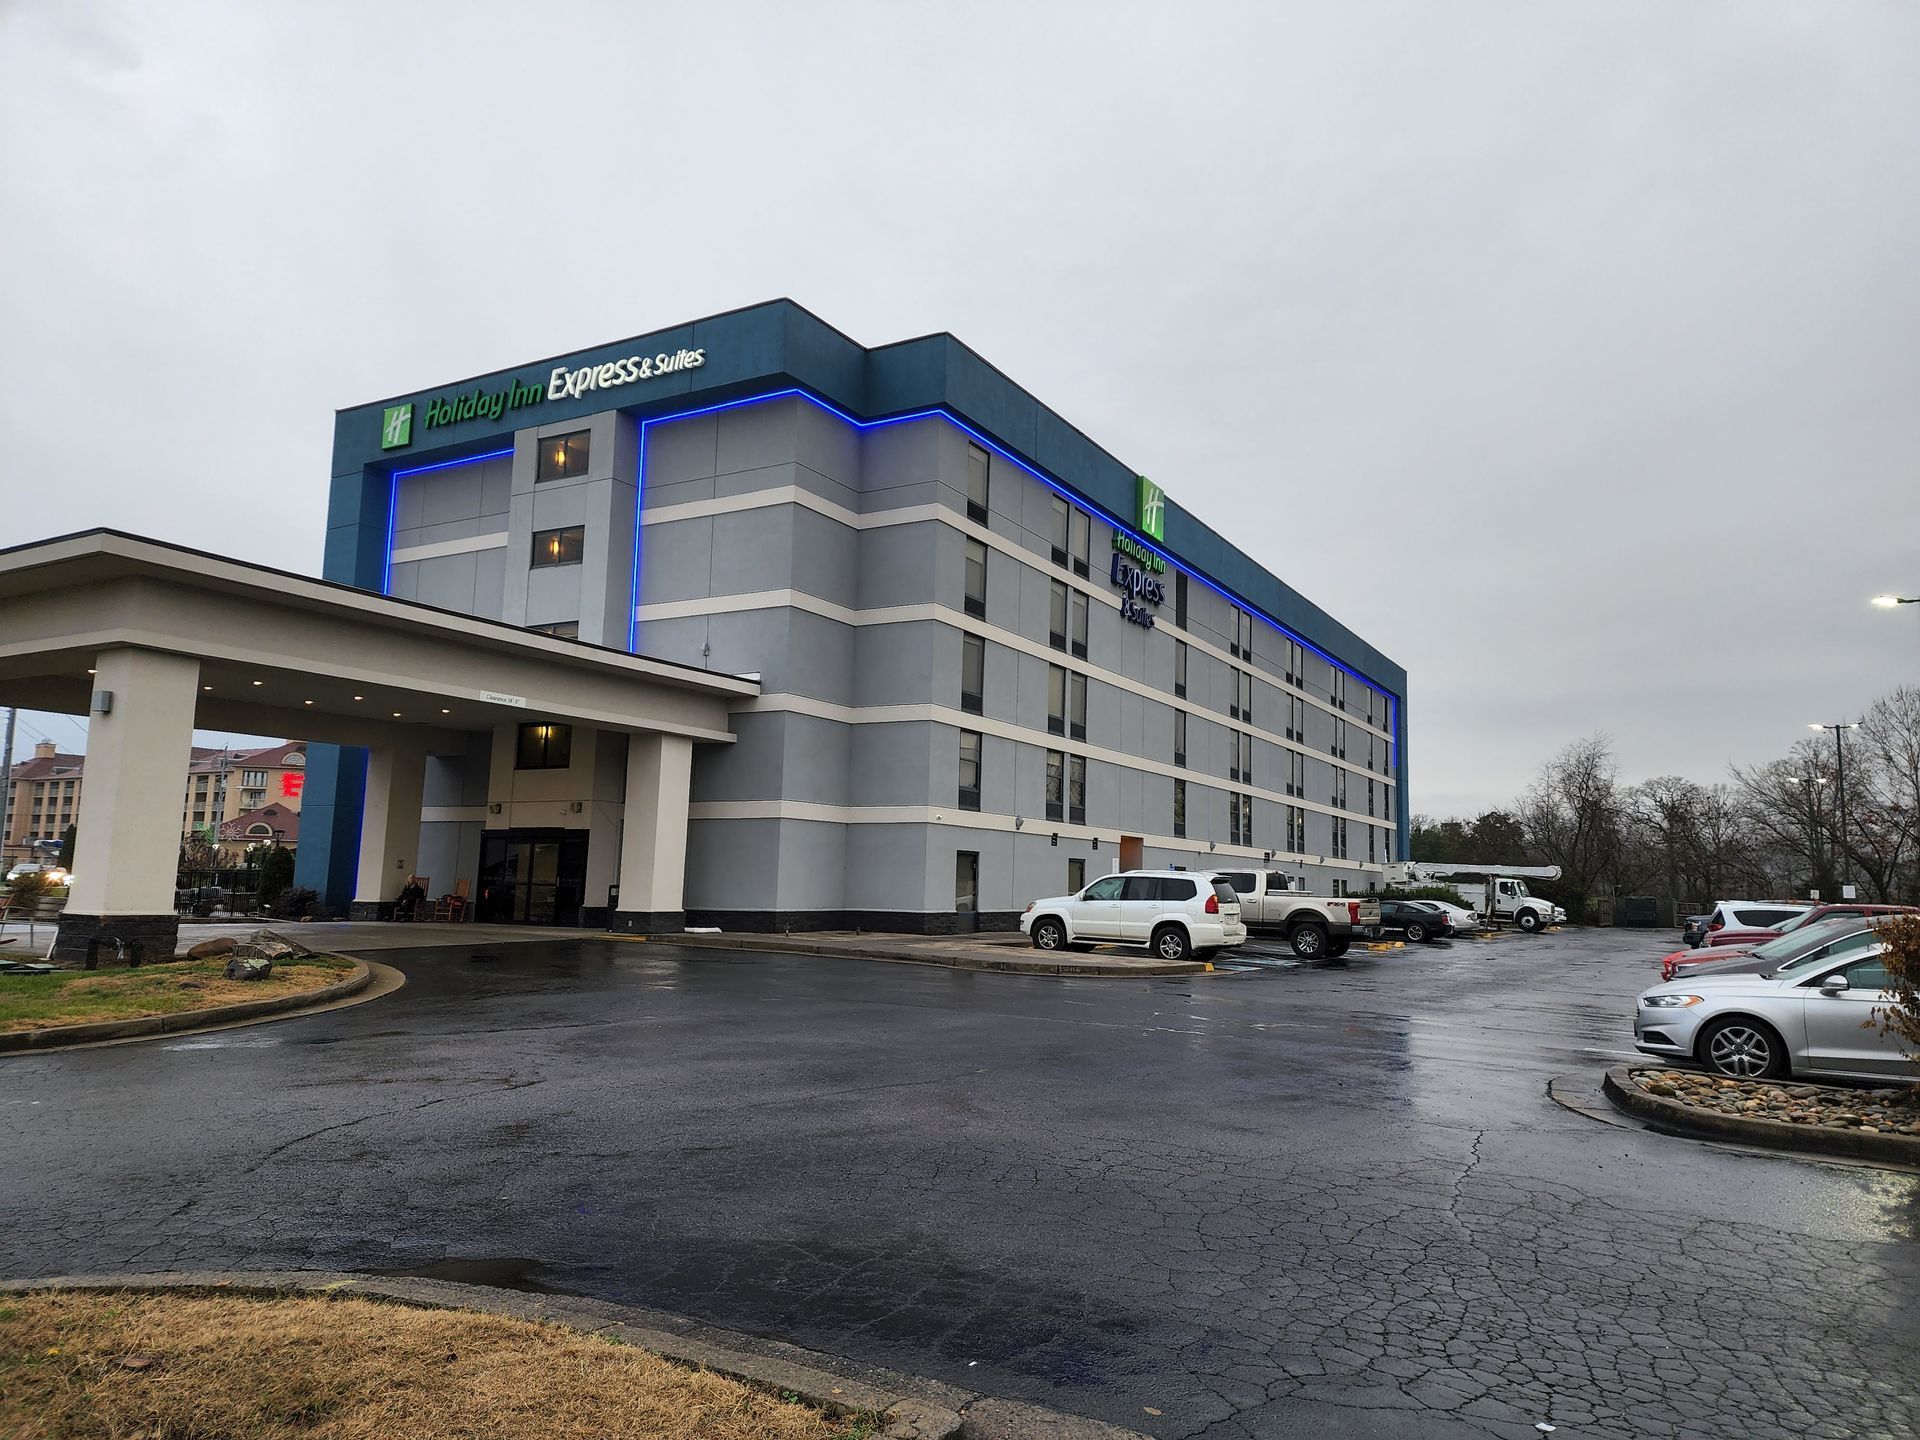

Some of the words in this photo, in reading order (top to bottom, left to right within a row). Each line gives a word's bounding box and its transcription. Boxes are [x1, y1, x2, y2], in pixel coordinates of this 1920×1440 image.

[424, 389, 505, 429] Holiday
[508, 379, 544, 410] Inn
[547, 355, 642, 400] Express
[639, 355, 654, 379] &
[655, 348, 706, 374] Suites
[1116, 529, 1152, 570] Holiday
[1153, 555, 1167, 575] Inn
[1115, 556, 1166, 604] Express
